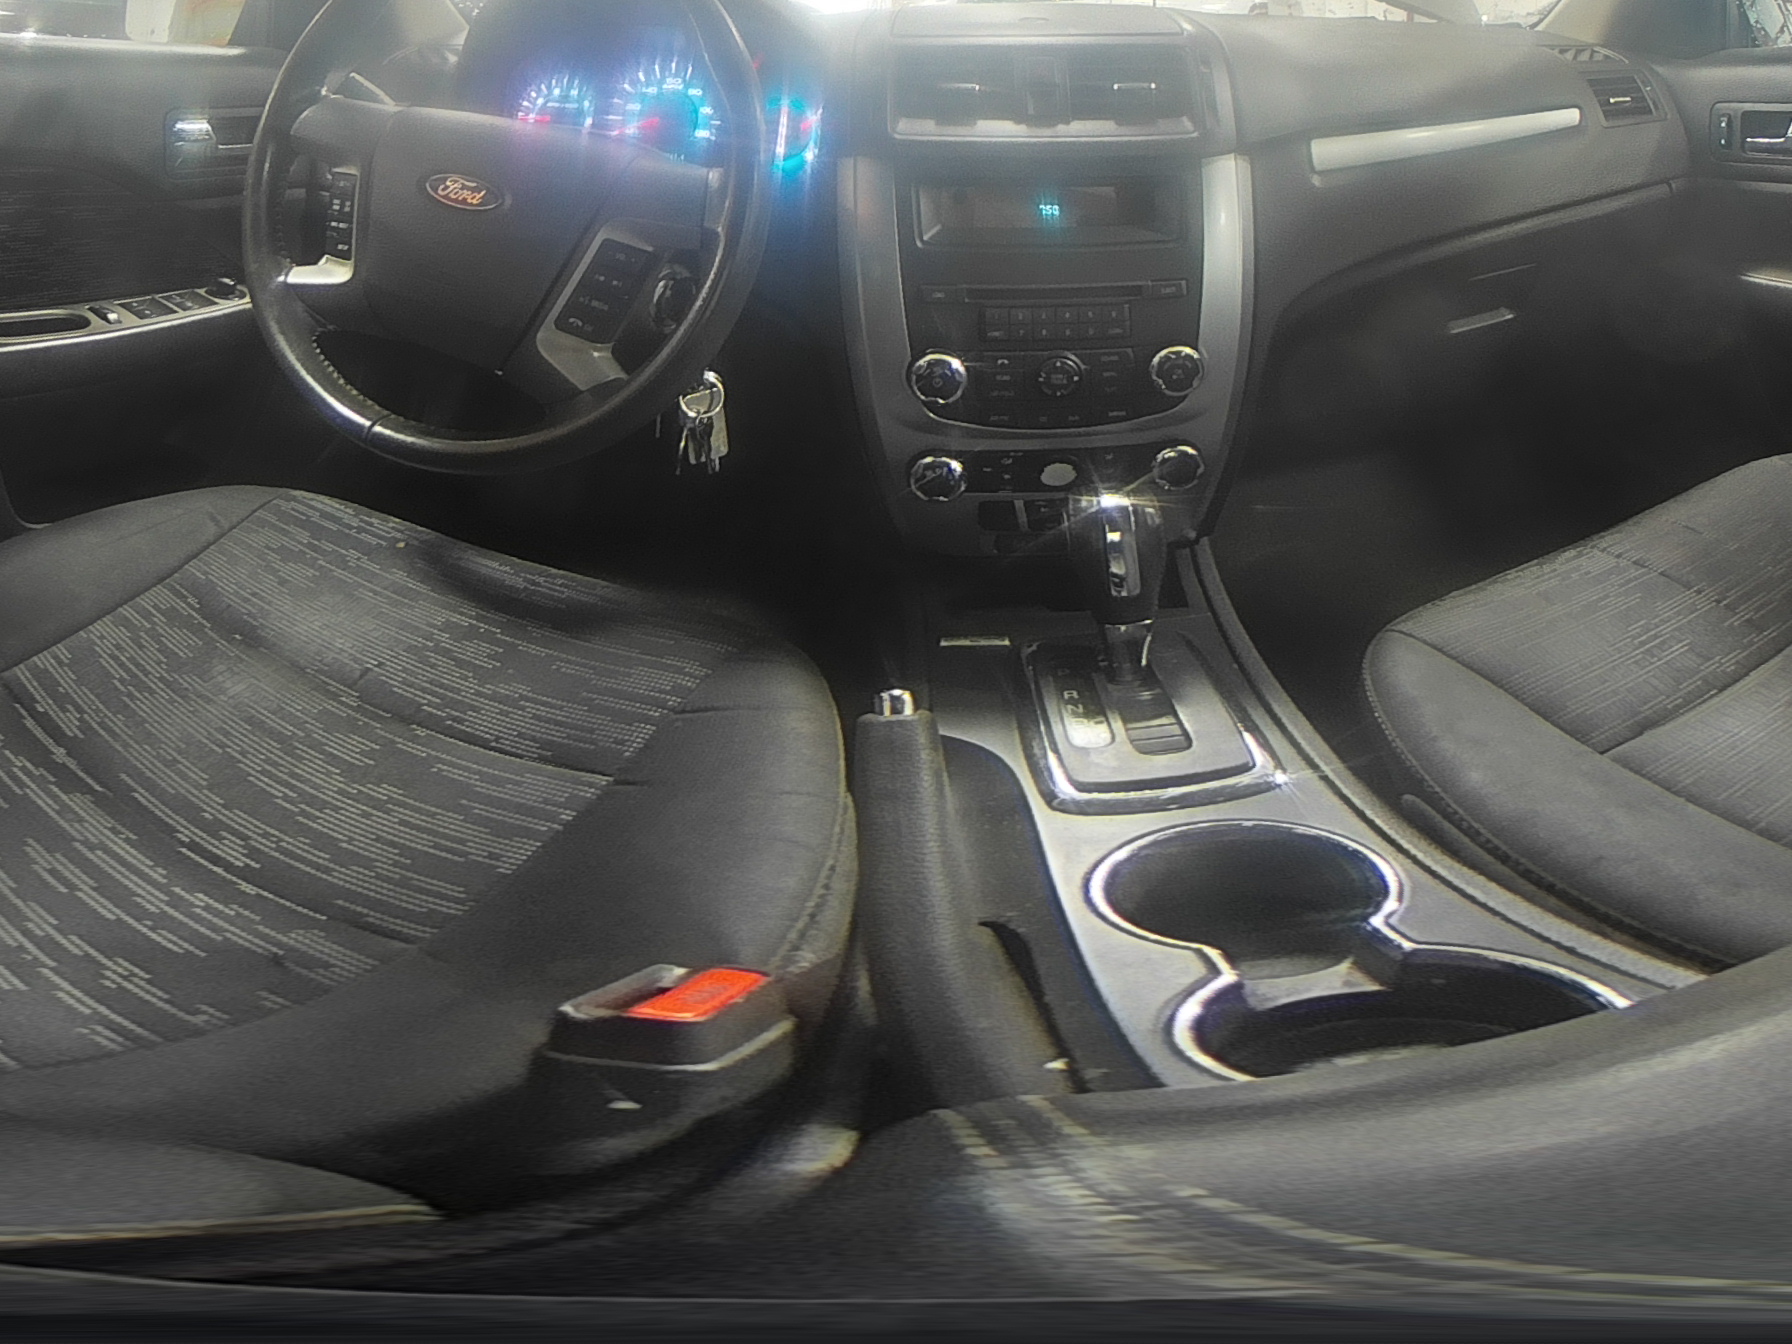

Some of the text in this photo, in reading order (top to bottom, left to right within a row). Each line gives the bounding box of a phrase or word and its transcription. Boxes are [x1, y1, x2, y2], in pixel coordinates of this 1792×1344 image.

[437, 176, 487, 205] Ford
[1063, 690, 1080, 700] R
[1067, 704, 1084, 713] N
